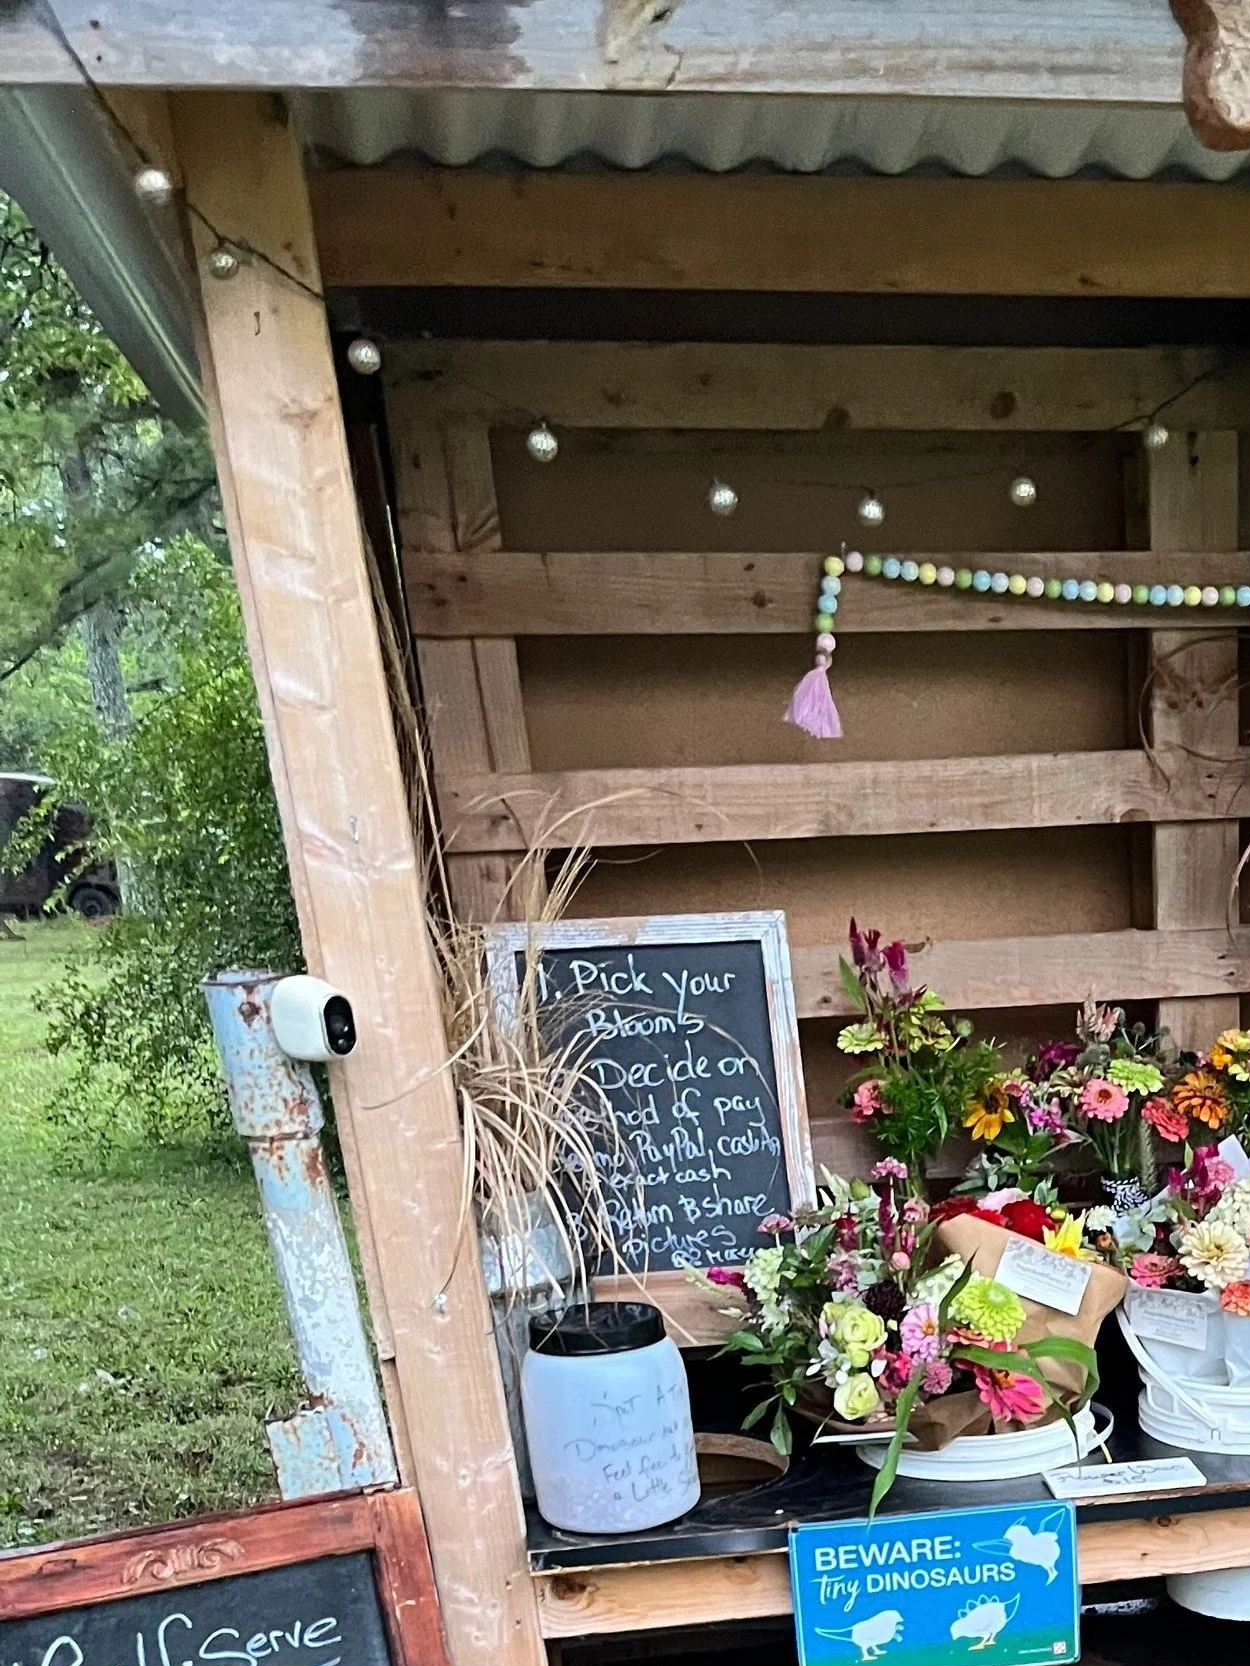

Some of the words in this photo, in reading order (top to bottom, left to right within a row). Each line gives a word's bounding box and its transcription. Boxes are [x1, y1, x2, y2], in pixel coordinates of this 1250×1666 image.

[570, 953, 653, 995] Pick
[590, 1040, 711, 1089] Decide
[717, 1056, 759, 1076] on
[672, 1088, 700, 1125] of
[713, 1096, 766, 1127] pay
[675, 1149, 732, 1183] cash
[702, 1183, 775, 1218] share
[814, 1535, 962, 1571] BEWARE:
[810, 1574, 862, 1613] tiny
[866, 1562, 1016, 1593] DINOSAURS
